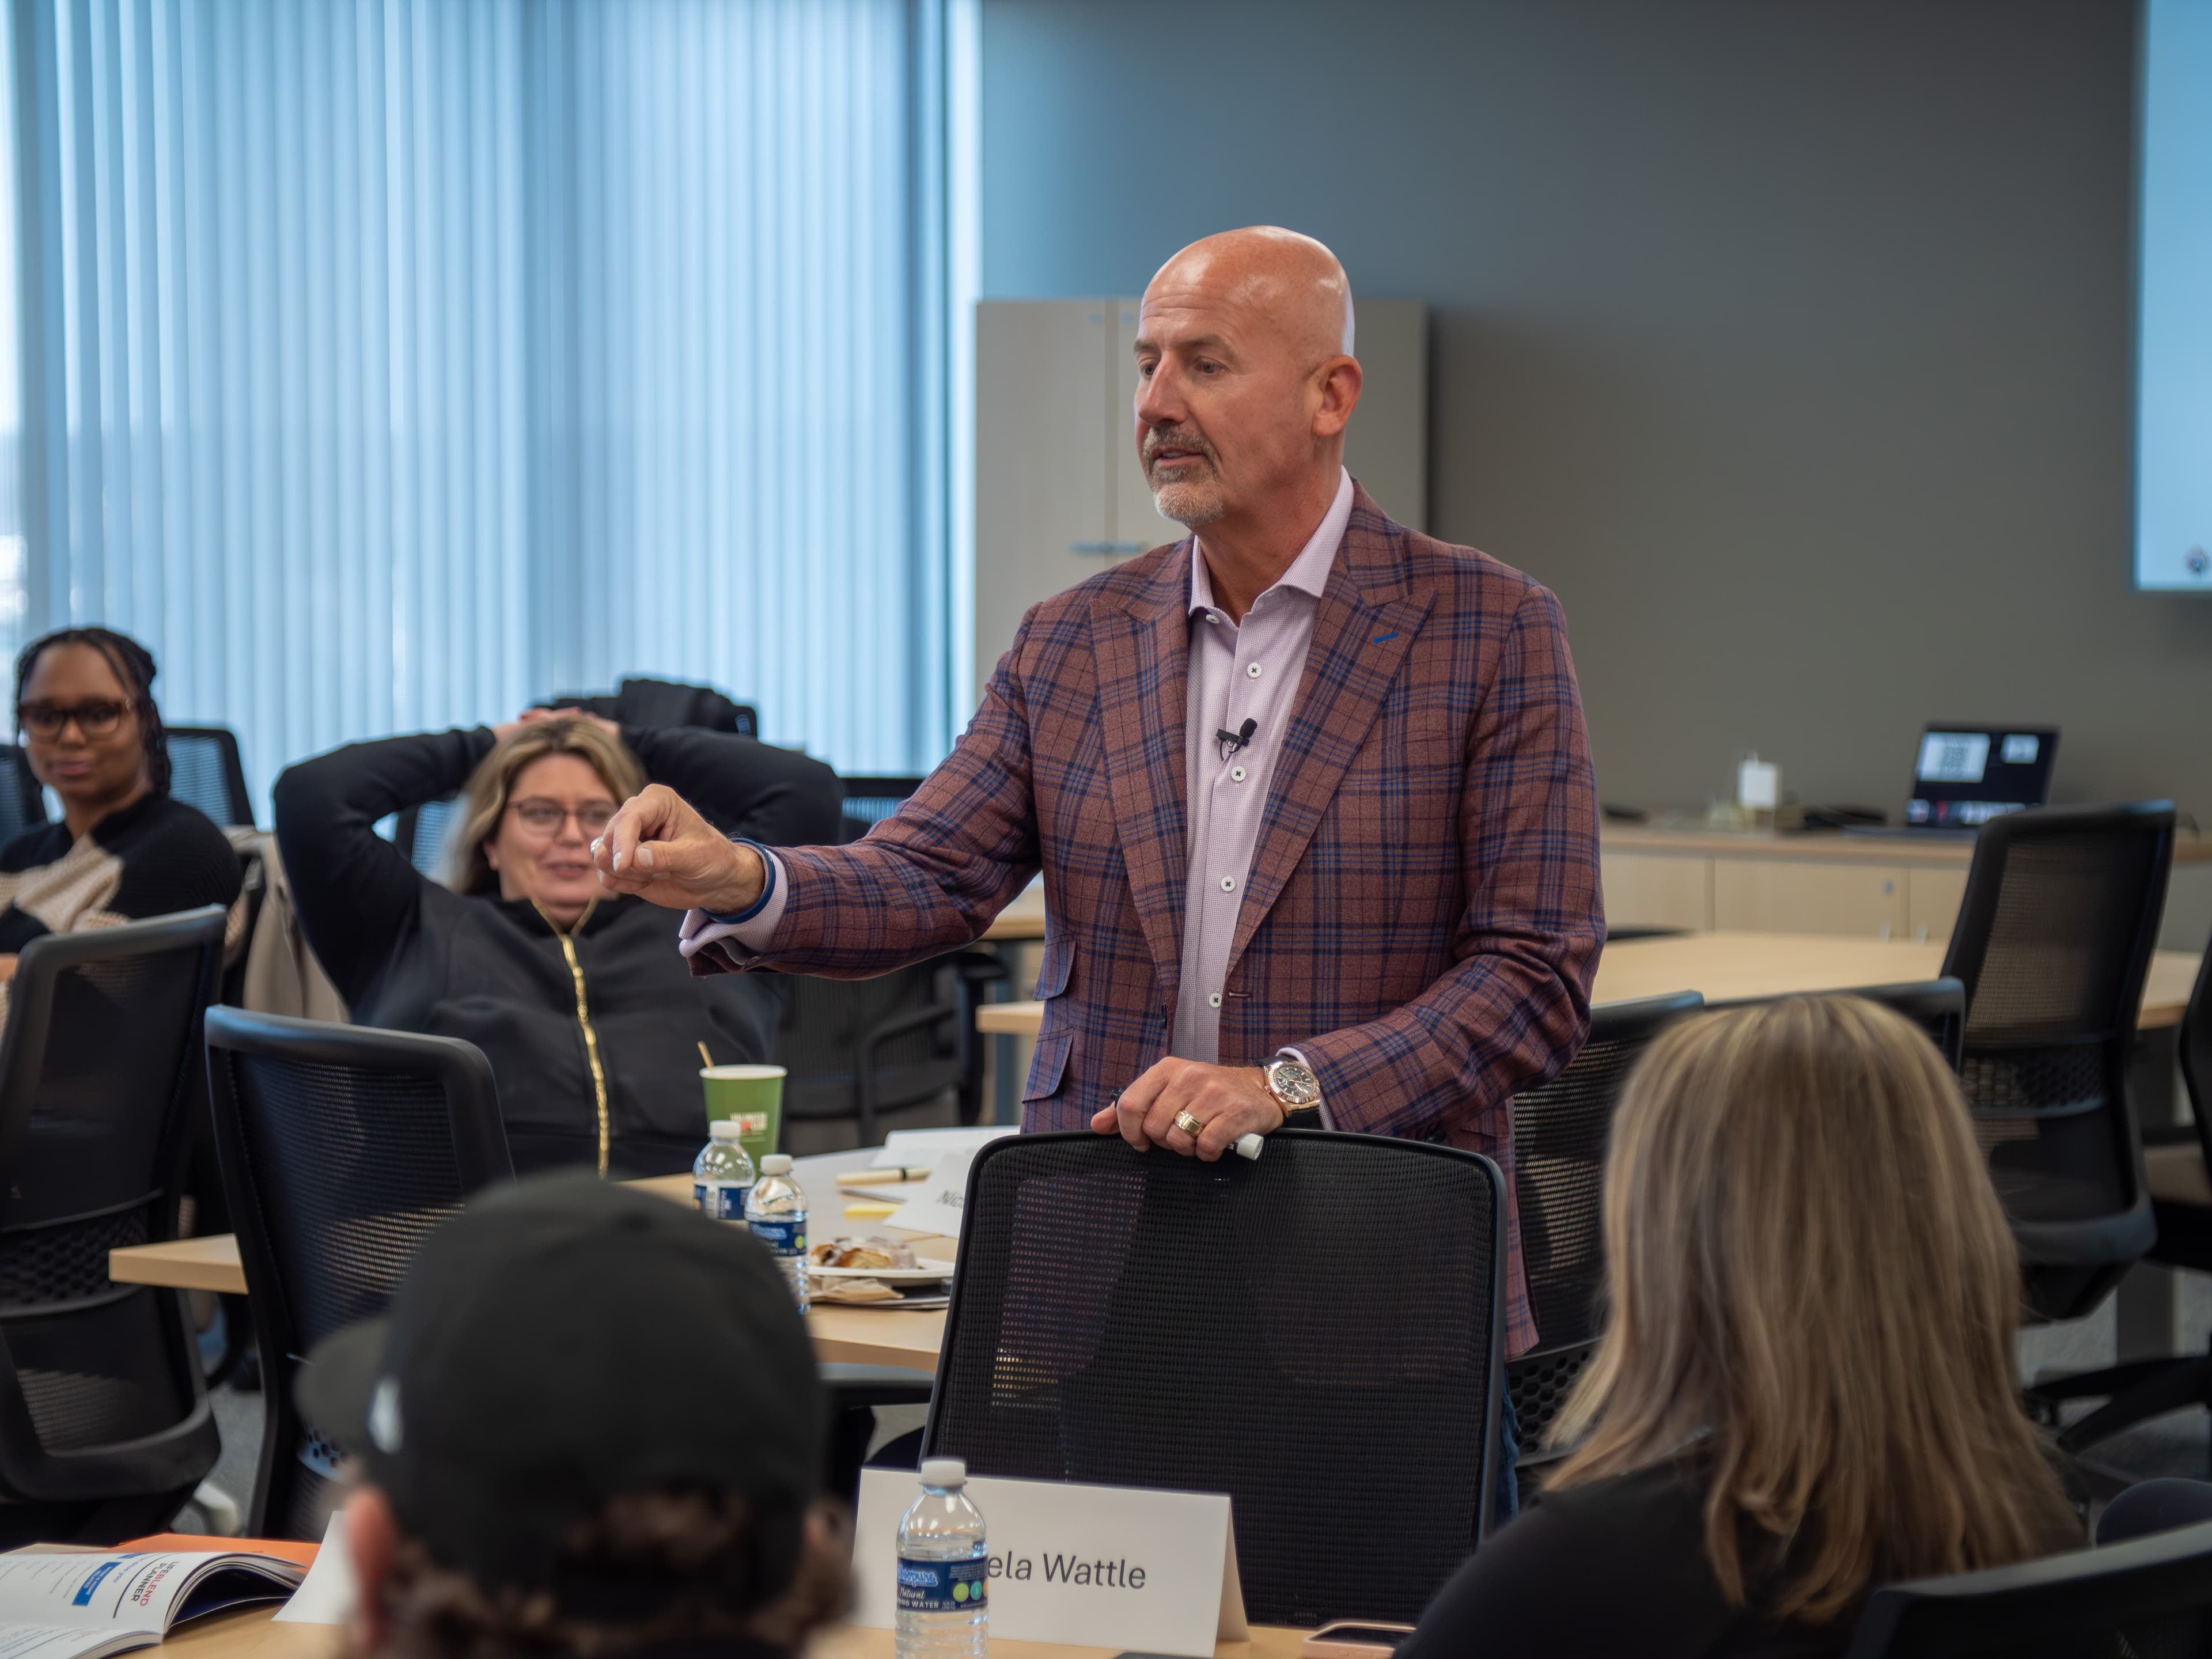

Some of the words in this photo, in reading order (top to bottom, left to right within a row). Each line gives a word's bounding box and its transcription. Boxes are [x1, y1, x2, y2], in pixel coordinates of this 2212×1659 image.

[130, 1563, 166, 1601] PLANNER
[139, 1562, 180, 1607] LIFEBLEND
[987, 1551, 1032, 1581] ela
[1043, 1552, 1146, 1590] Wattle
[900, 1586, 926, 1600] Natural
[911, 1600, 940, 1609] WATER
